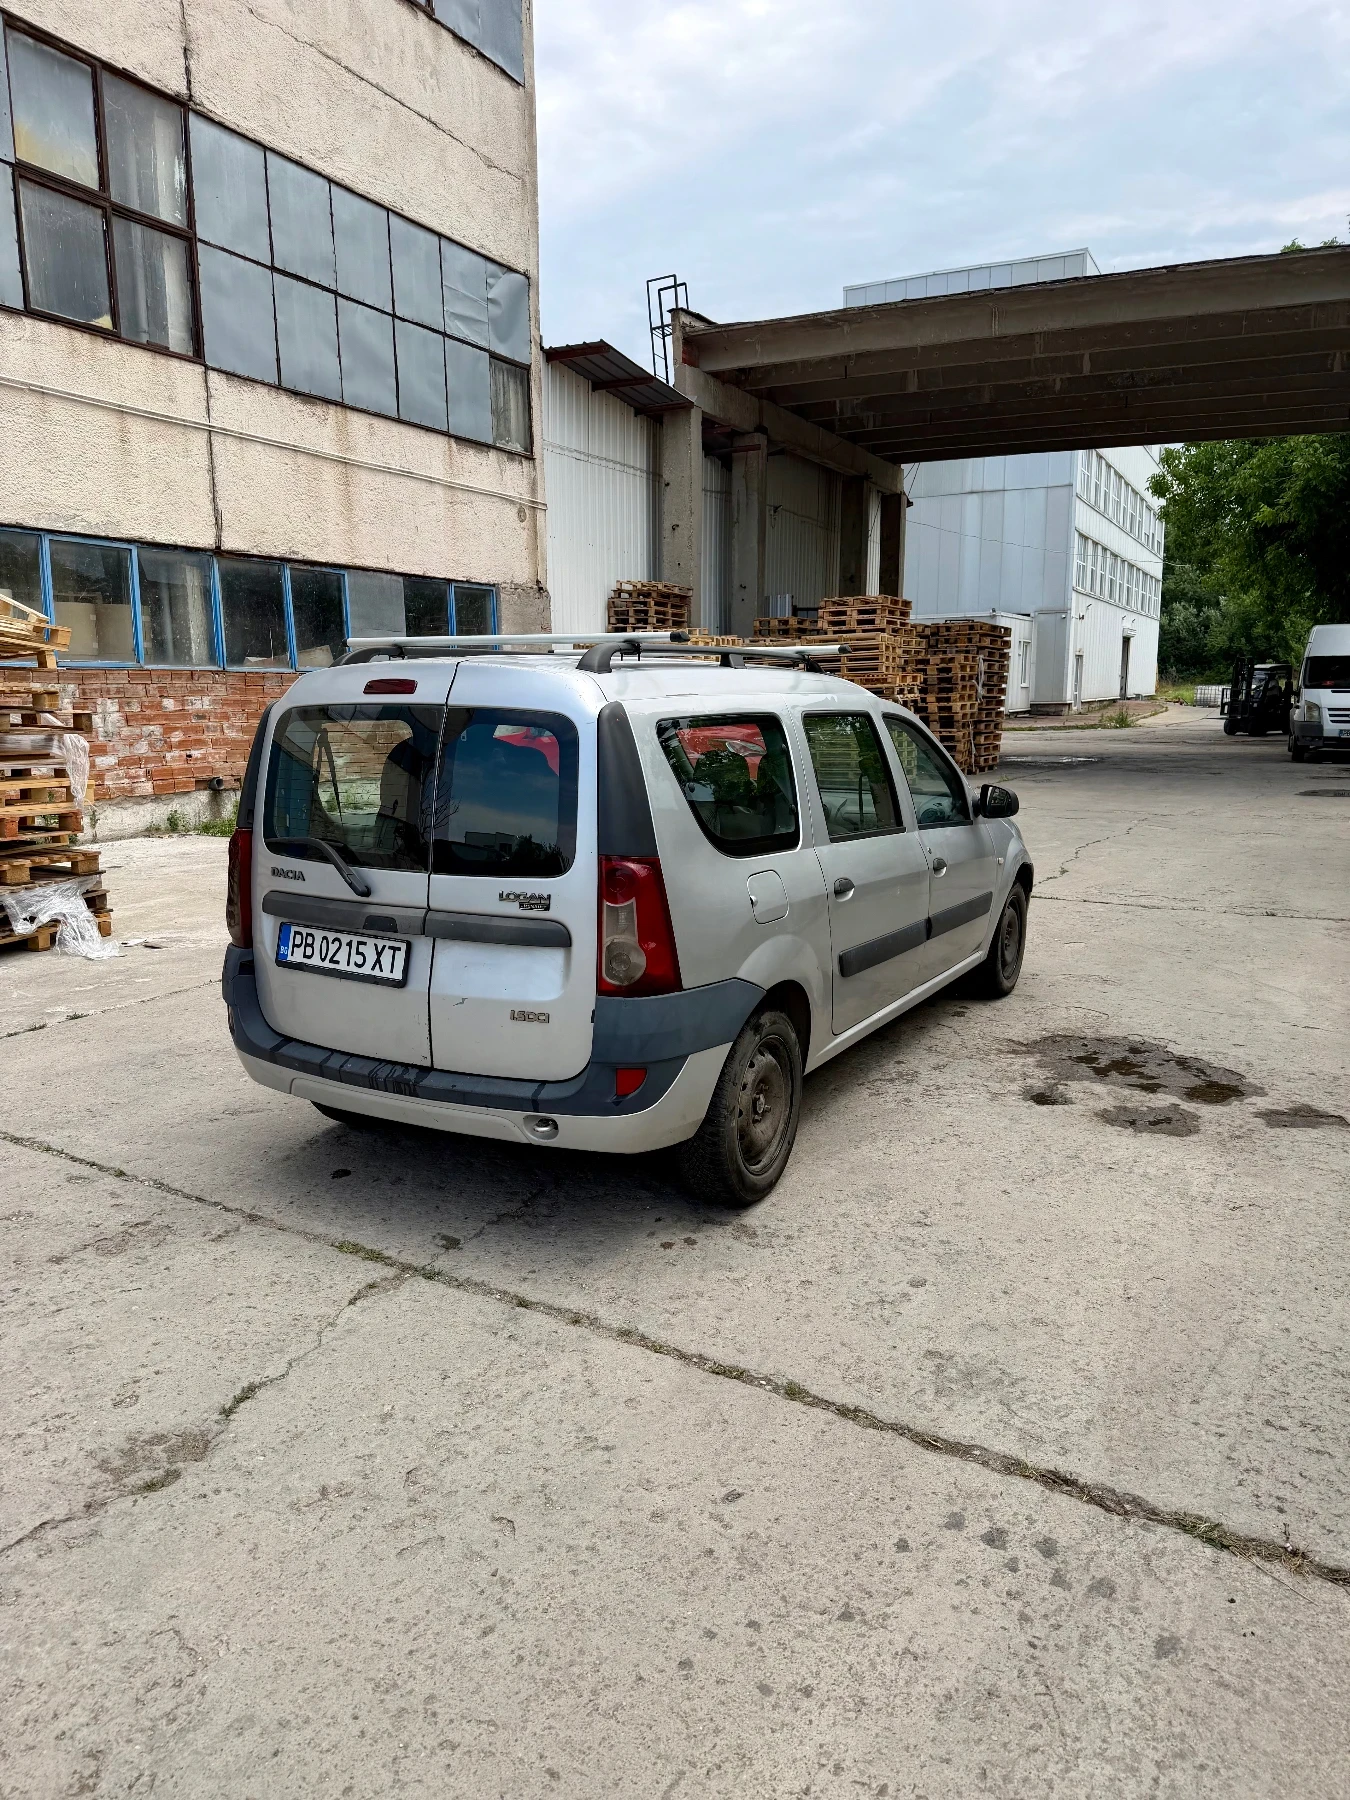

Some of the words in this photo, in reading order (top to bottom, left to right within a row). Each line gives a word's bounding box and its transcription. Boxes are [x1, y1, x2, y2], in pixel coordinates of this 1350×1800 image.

[271, 867, 305, 881] DACIA
[499, 890, 551, 904] LOGAN
[291, 930, 315, 960] PB
[319, 935, 367, 968] 0215
[371, 943, 401, 973] XT
